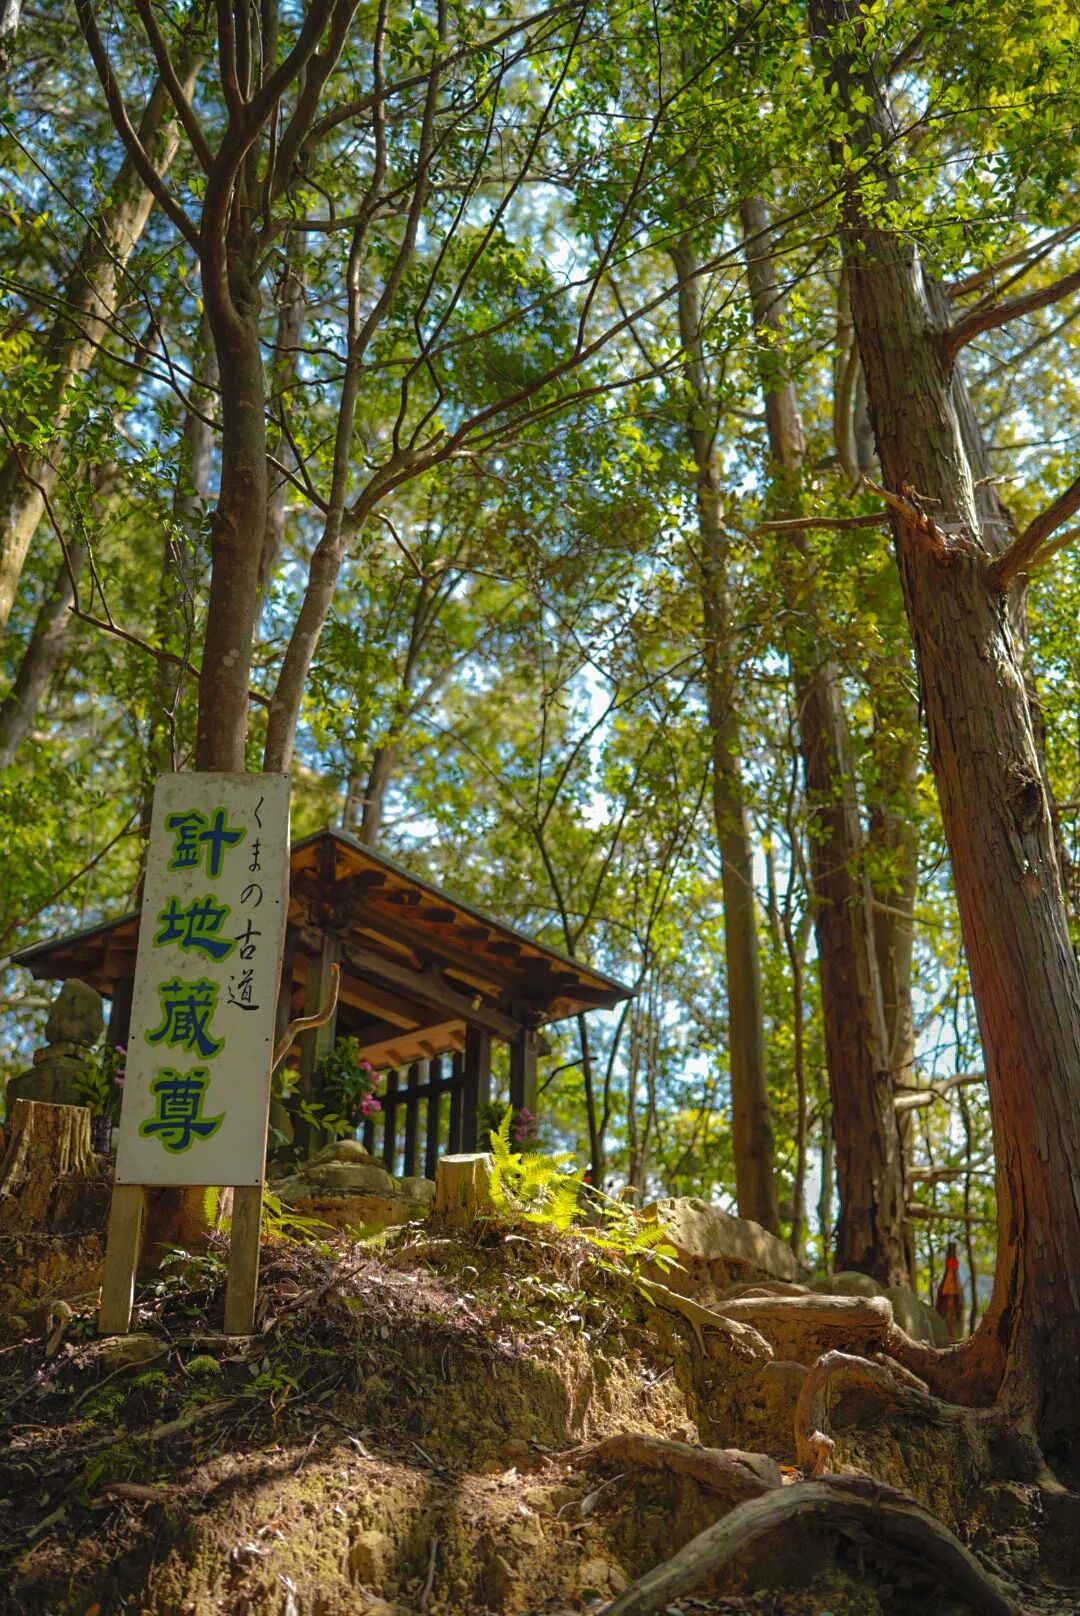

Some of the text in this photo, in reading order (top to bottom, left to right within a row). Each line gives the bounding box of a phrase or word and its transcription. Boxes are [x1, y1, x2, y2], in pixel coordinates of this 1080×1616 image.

[140, 807, 246, 1153] 針地蔵尊
[227, 796, 264, 1011] くまの古道
